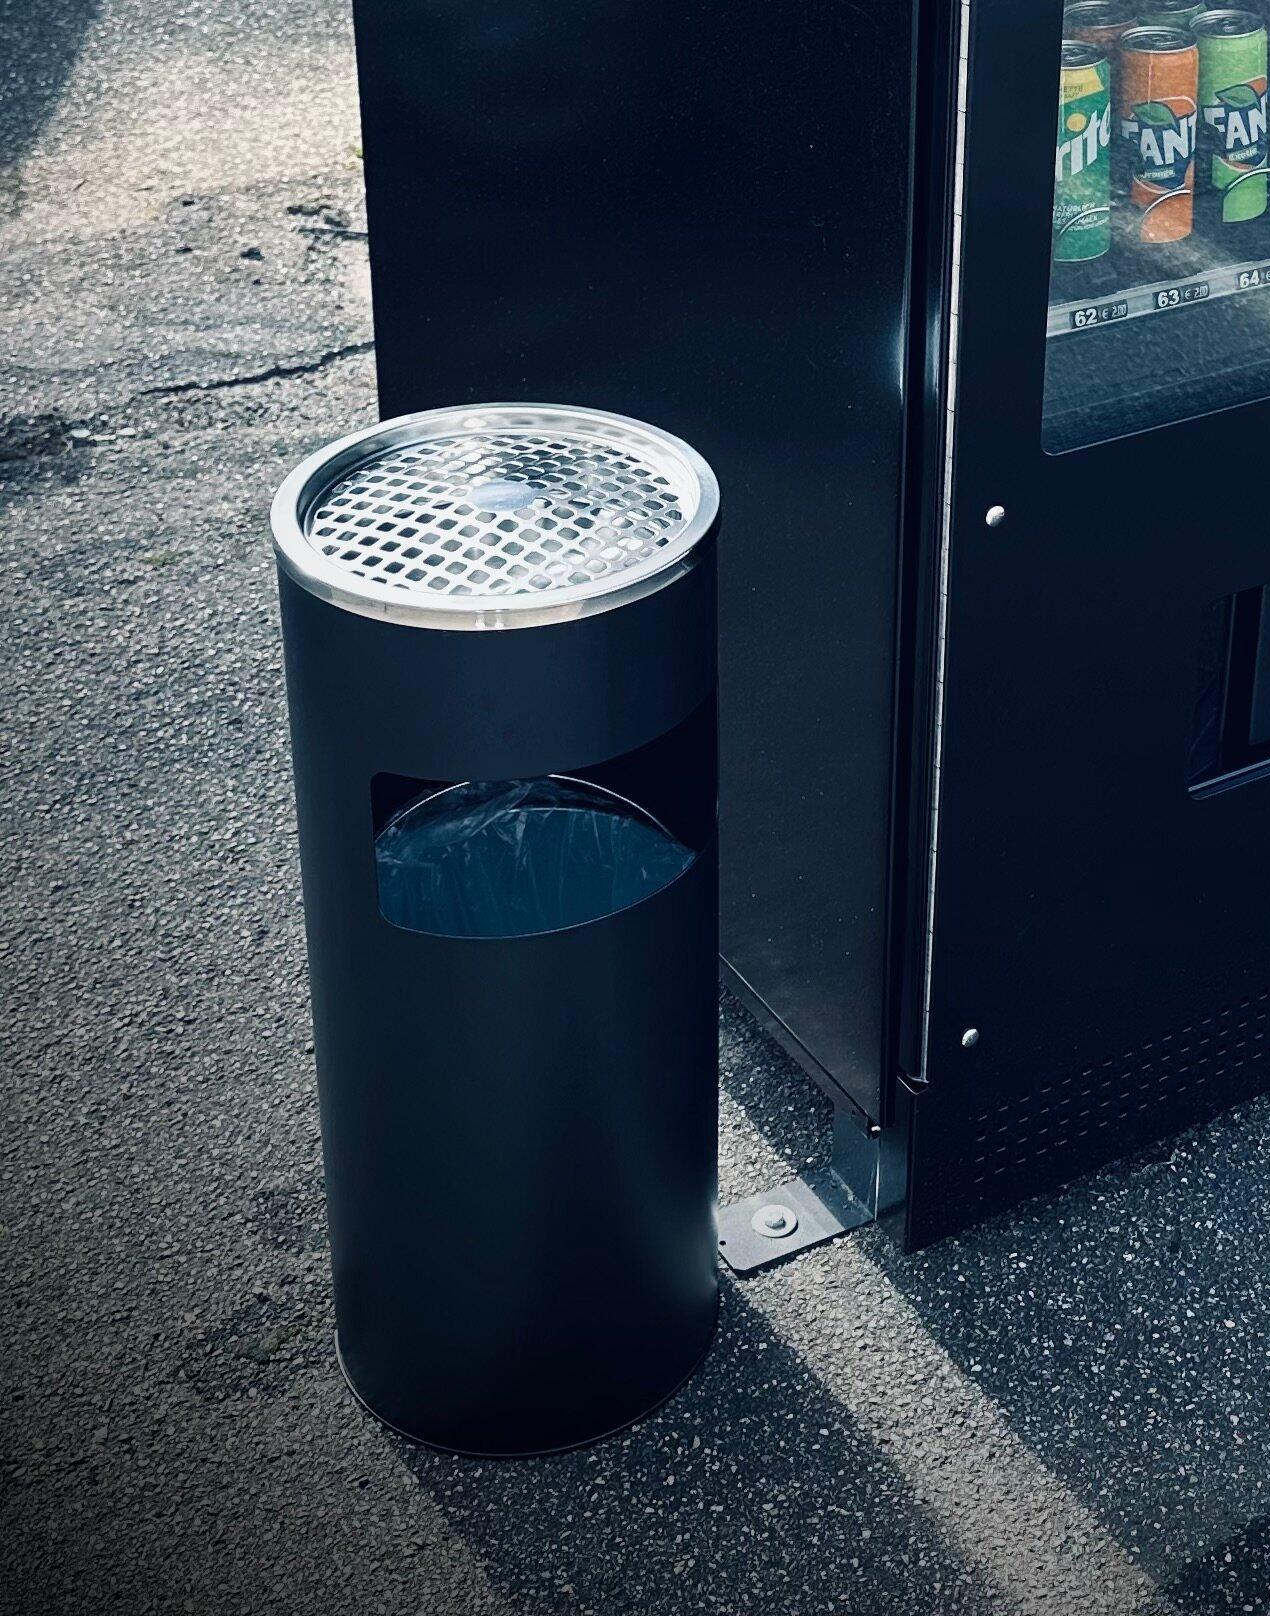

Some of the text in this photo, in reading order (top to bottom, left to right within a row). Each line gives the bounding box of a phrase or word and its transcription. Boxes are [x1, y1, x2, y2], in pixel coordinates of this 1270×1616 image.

[1239, 270, 1259, 288] 64
[1158, 289, 1179, 307] 63
[1075, 309, 1097, 327] 62
